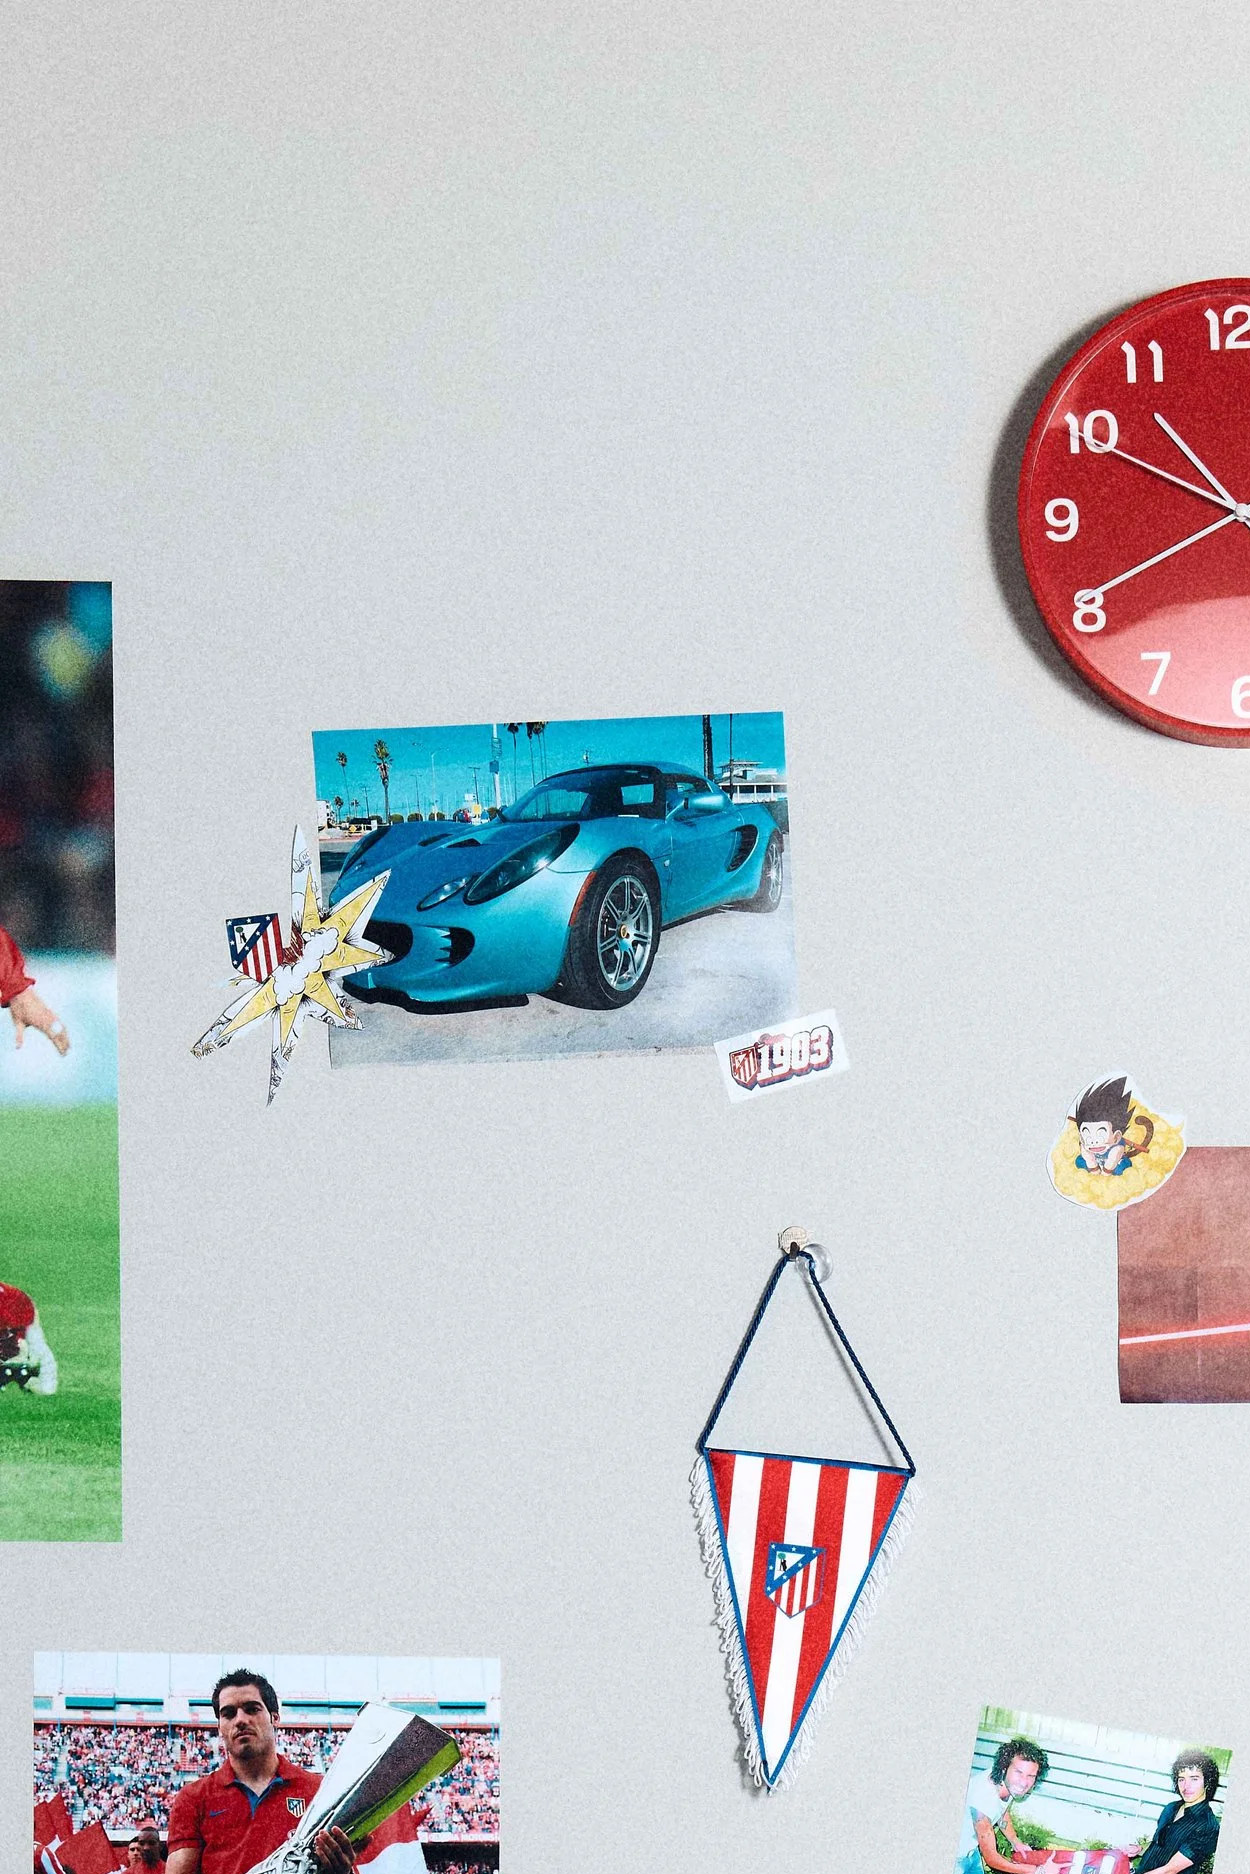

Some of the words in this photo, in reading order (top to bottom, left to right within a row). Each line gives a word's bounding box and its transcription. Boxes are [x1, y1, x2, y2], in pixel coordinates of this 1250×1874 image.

[1121, 340, 1163, 383] 11
[1063, 409, 1119, 454] 10
[1043, 497, 1079, 542] 9
[1072, 588, 1106, 633] 8
[1140, 651, 1172, 695] 7
[756, 1025, 834, 1088] 1903
